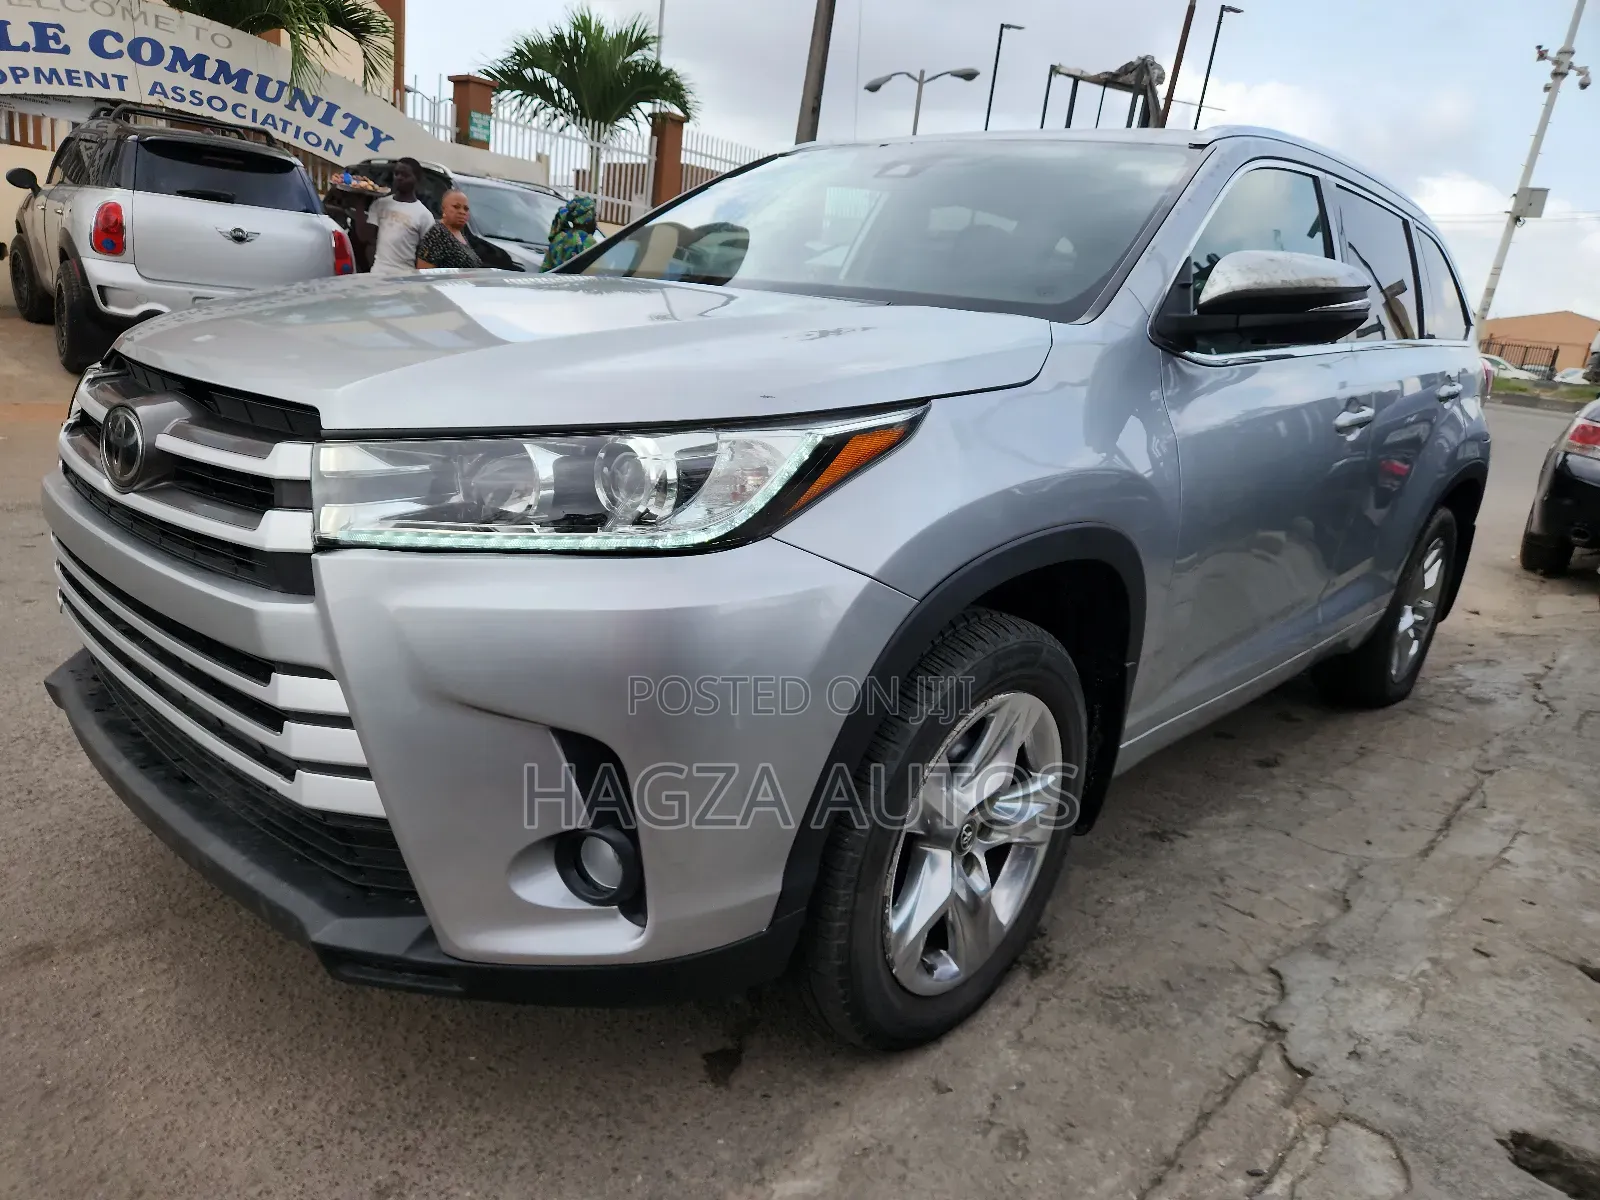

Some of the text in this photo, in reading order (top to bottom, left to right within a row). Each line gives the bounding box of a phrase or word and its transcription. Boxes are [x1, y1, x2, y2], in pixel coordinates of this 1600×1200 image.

[189, 22, 233, 49] TO
[88, 29, 395, 153] COMMUNITY
[148, 81, 344, 157] ASSOCIATION
